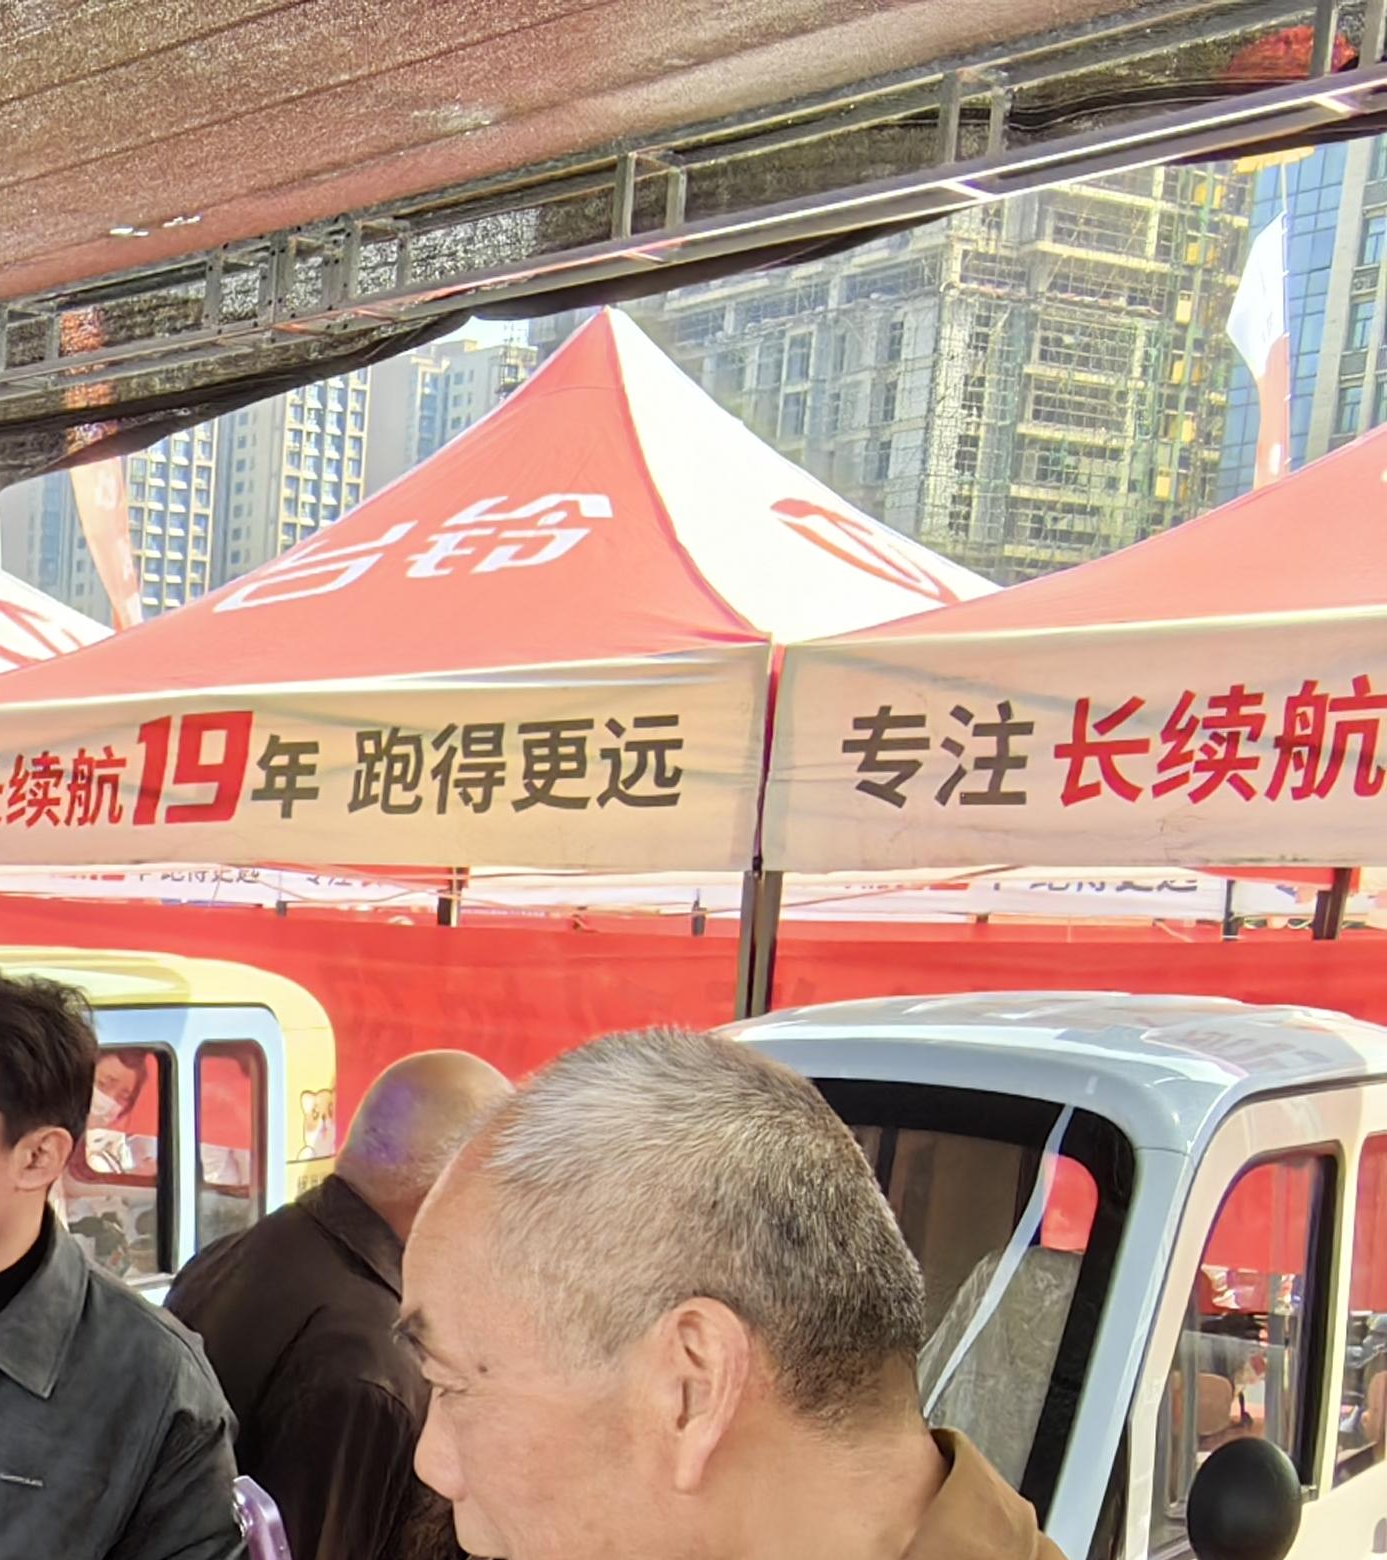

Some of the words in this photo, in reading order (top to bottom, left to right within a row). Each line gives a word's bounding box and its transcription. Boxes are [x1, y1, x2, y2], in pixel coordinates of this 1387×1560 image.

[213, 494, 613, 613] 台铃
[347, 714, 685, 817] 跑得更远
